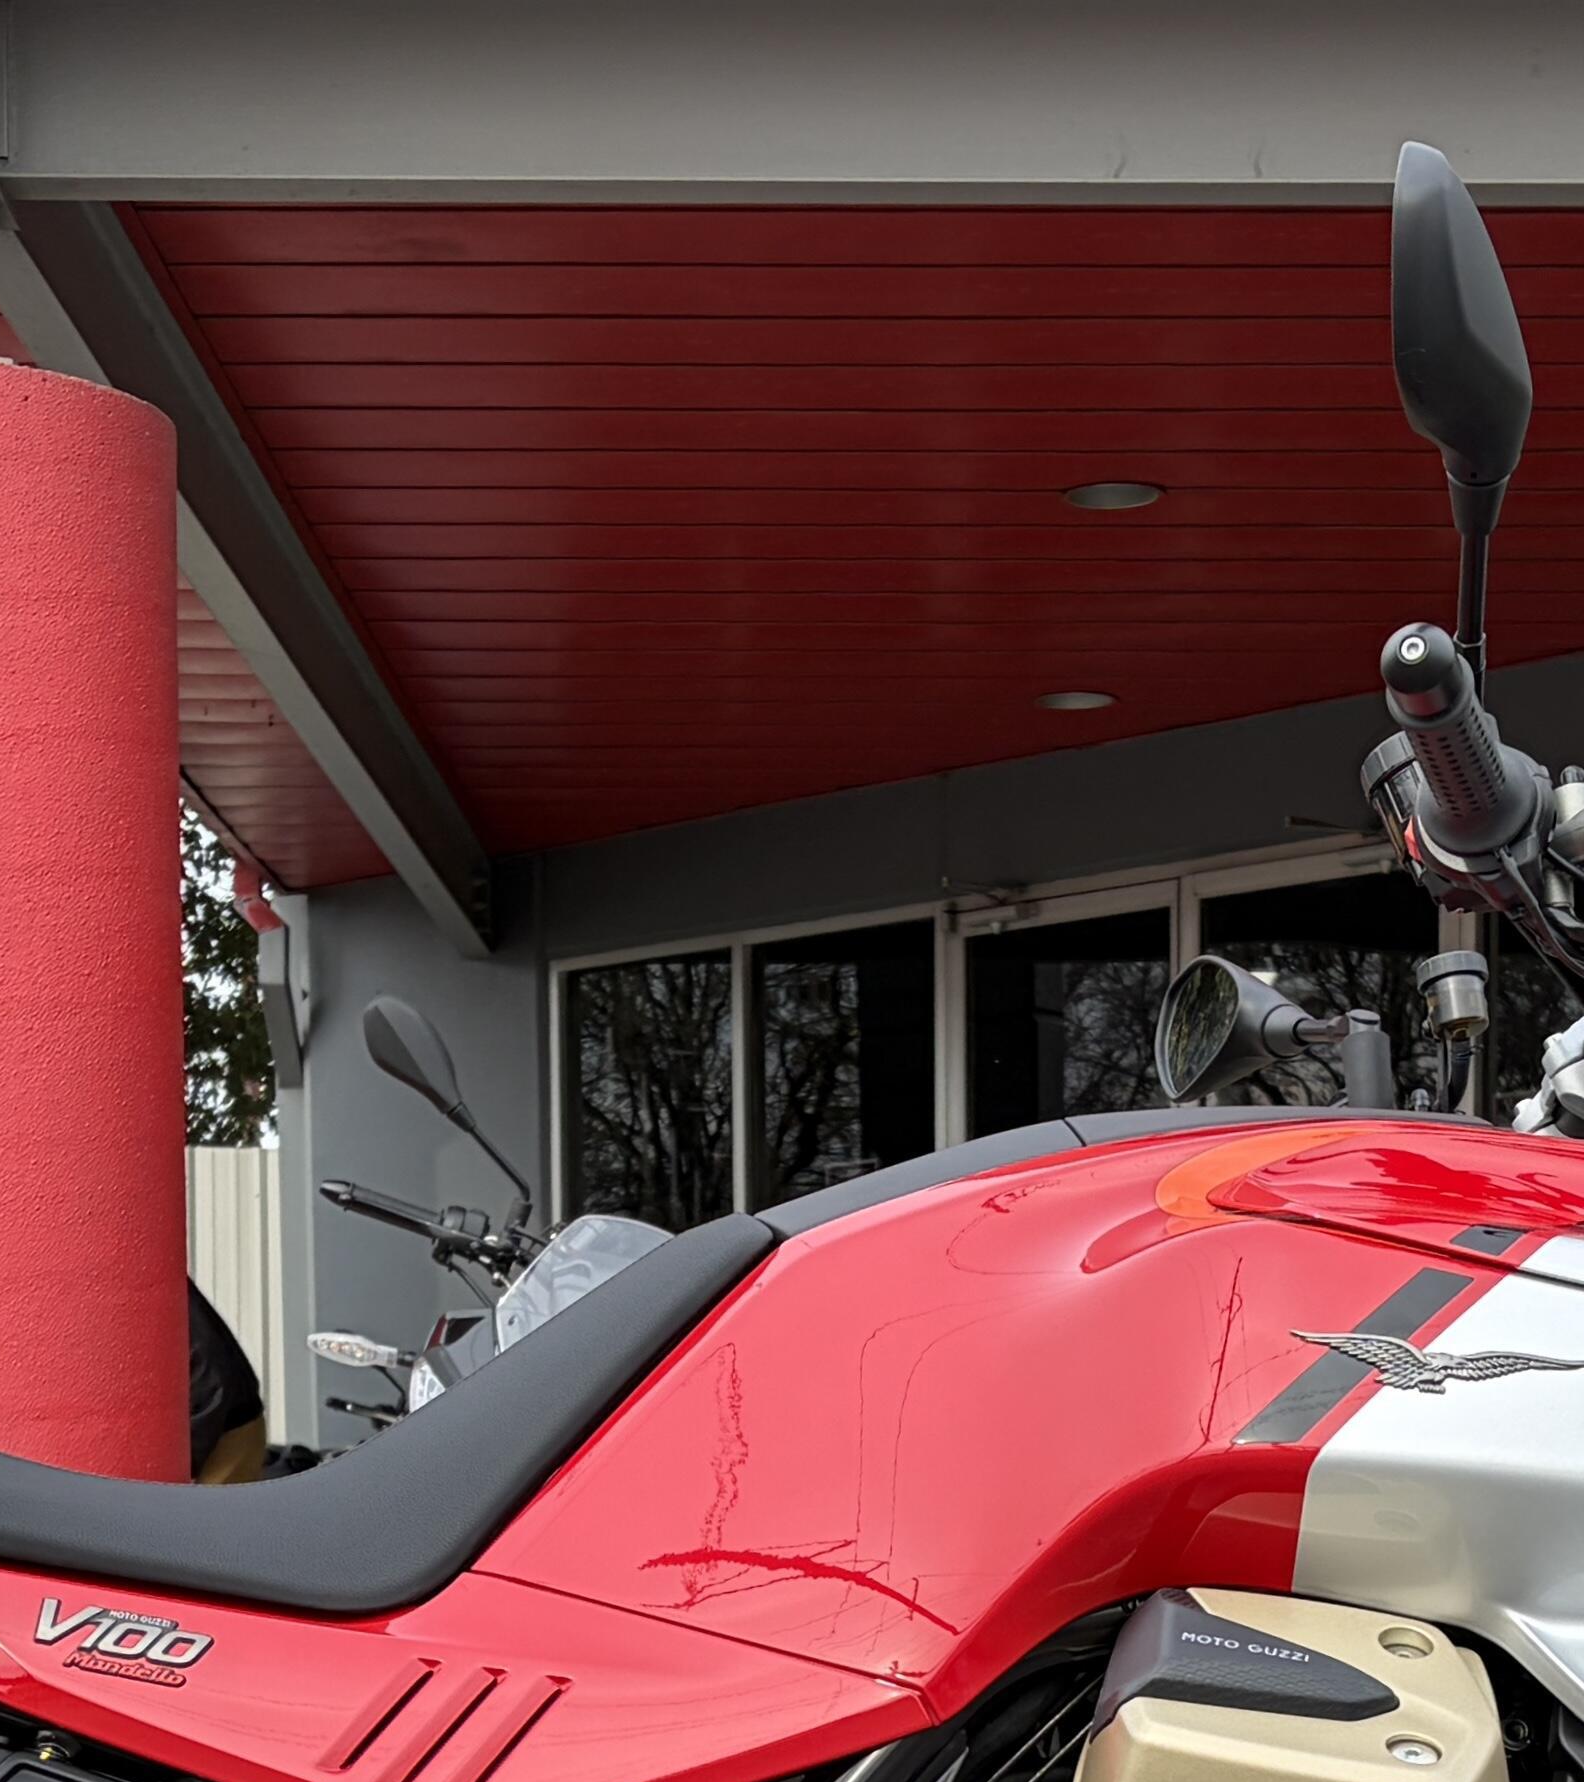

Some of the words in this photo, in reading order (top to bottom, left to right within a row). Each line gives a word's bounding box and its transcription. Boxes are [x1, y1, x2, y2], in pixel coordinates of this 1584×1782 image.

[34, 1597, 215, 1669] V100
[1181, 1631, 1240, 1649] MOTO
[1247, 1643, 1310, 1663] GUZZI
